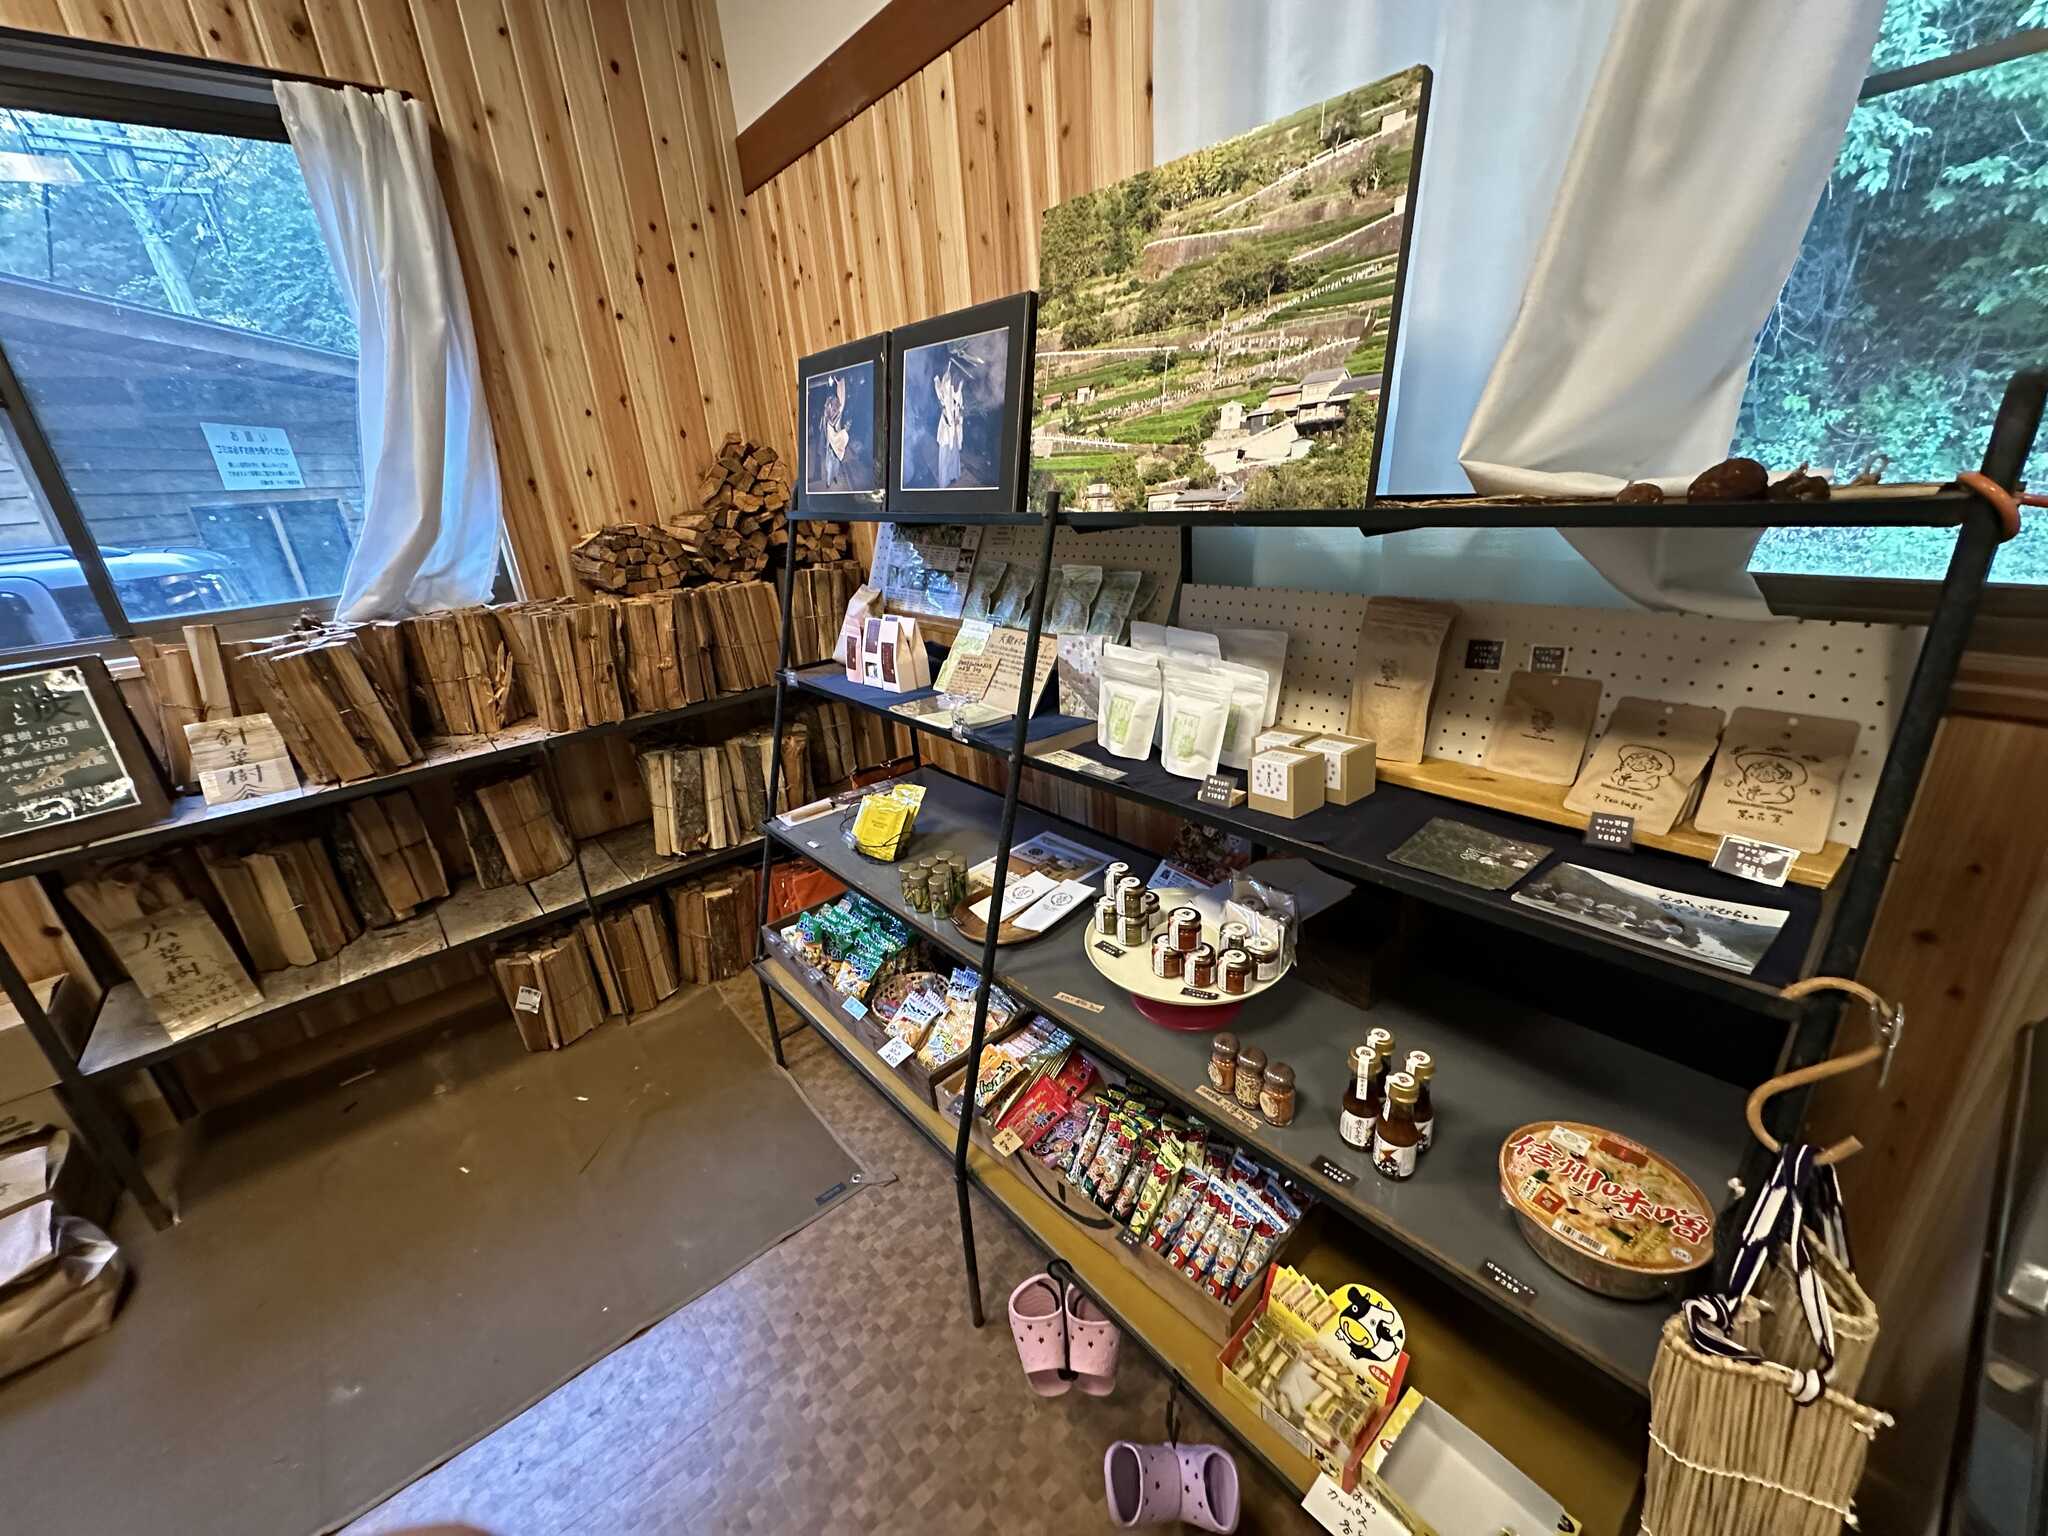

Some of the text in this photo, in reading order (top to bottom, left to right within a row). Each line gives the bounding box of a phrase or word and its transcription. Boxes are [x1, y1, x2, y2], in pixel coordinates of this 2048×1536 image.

[1508, 1134, 1711, 1245] 信州味噌
[1567, 1185, 1634, 1221] ラーメン
